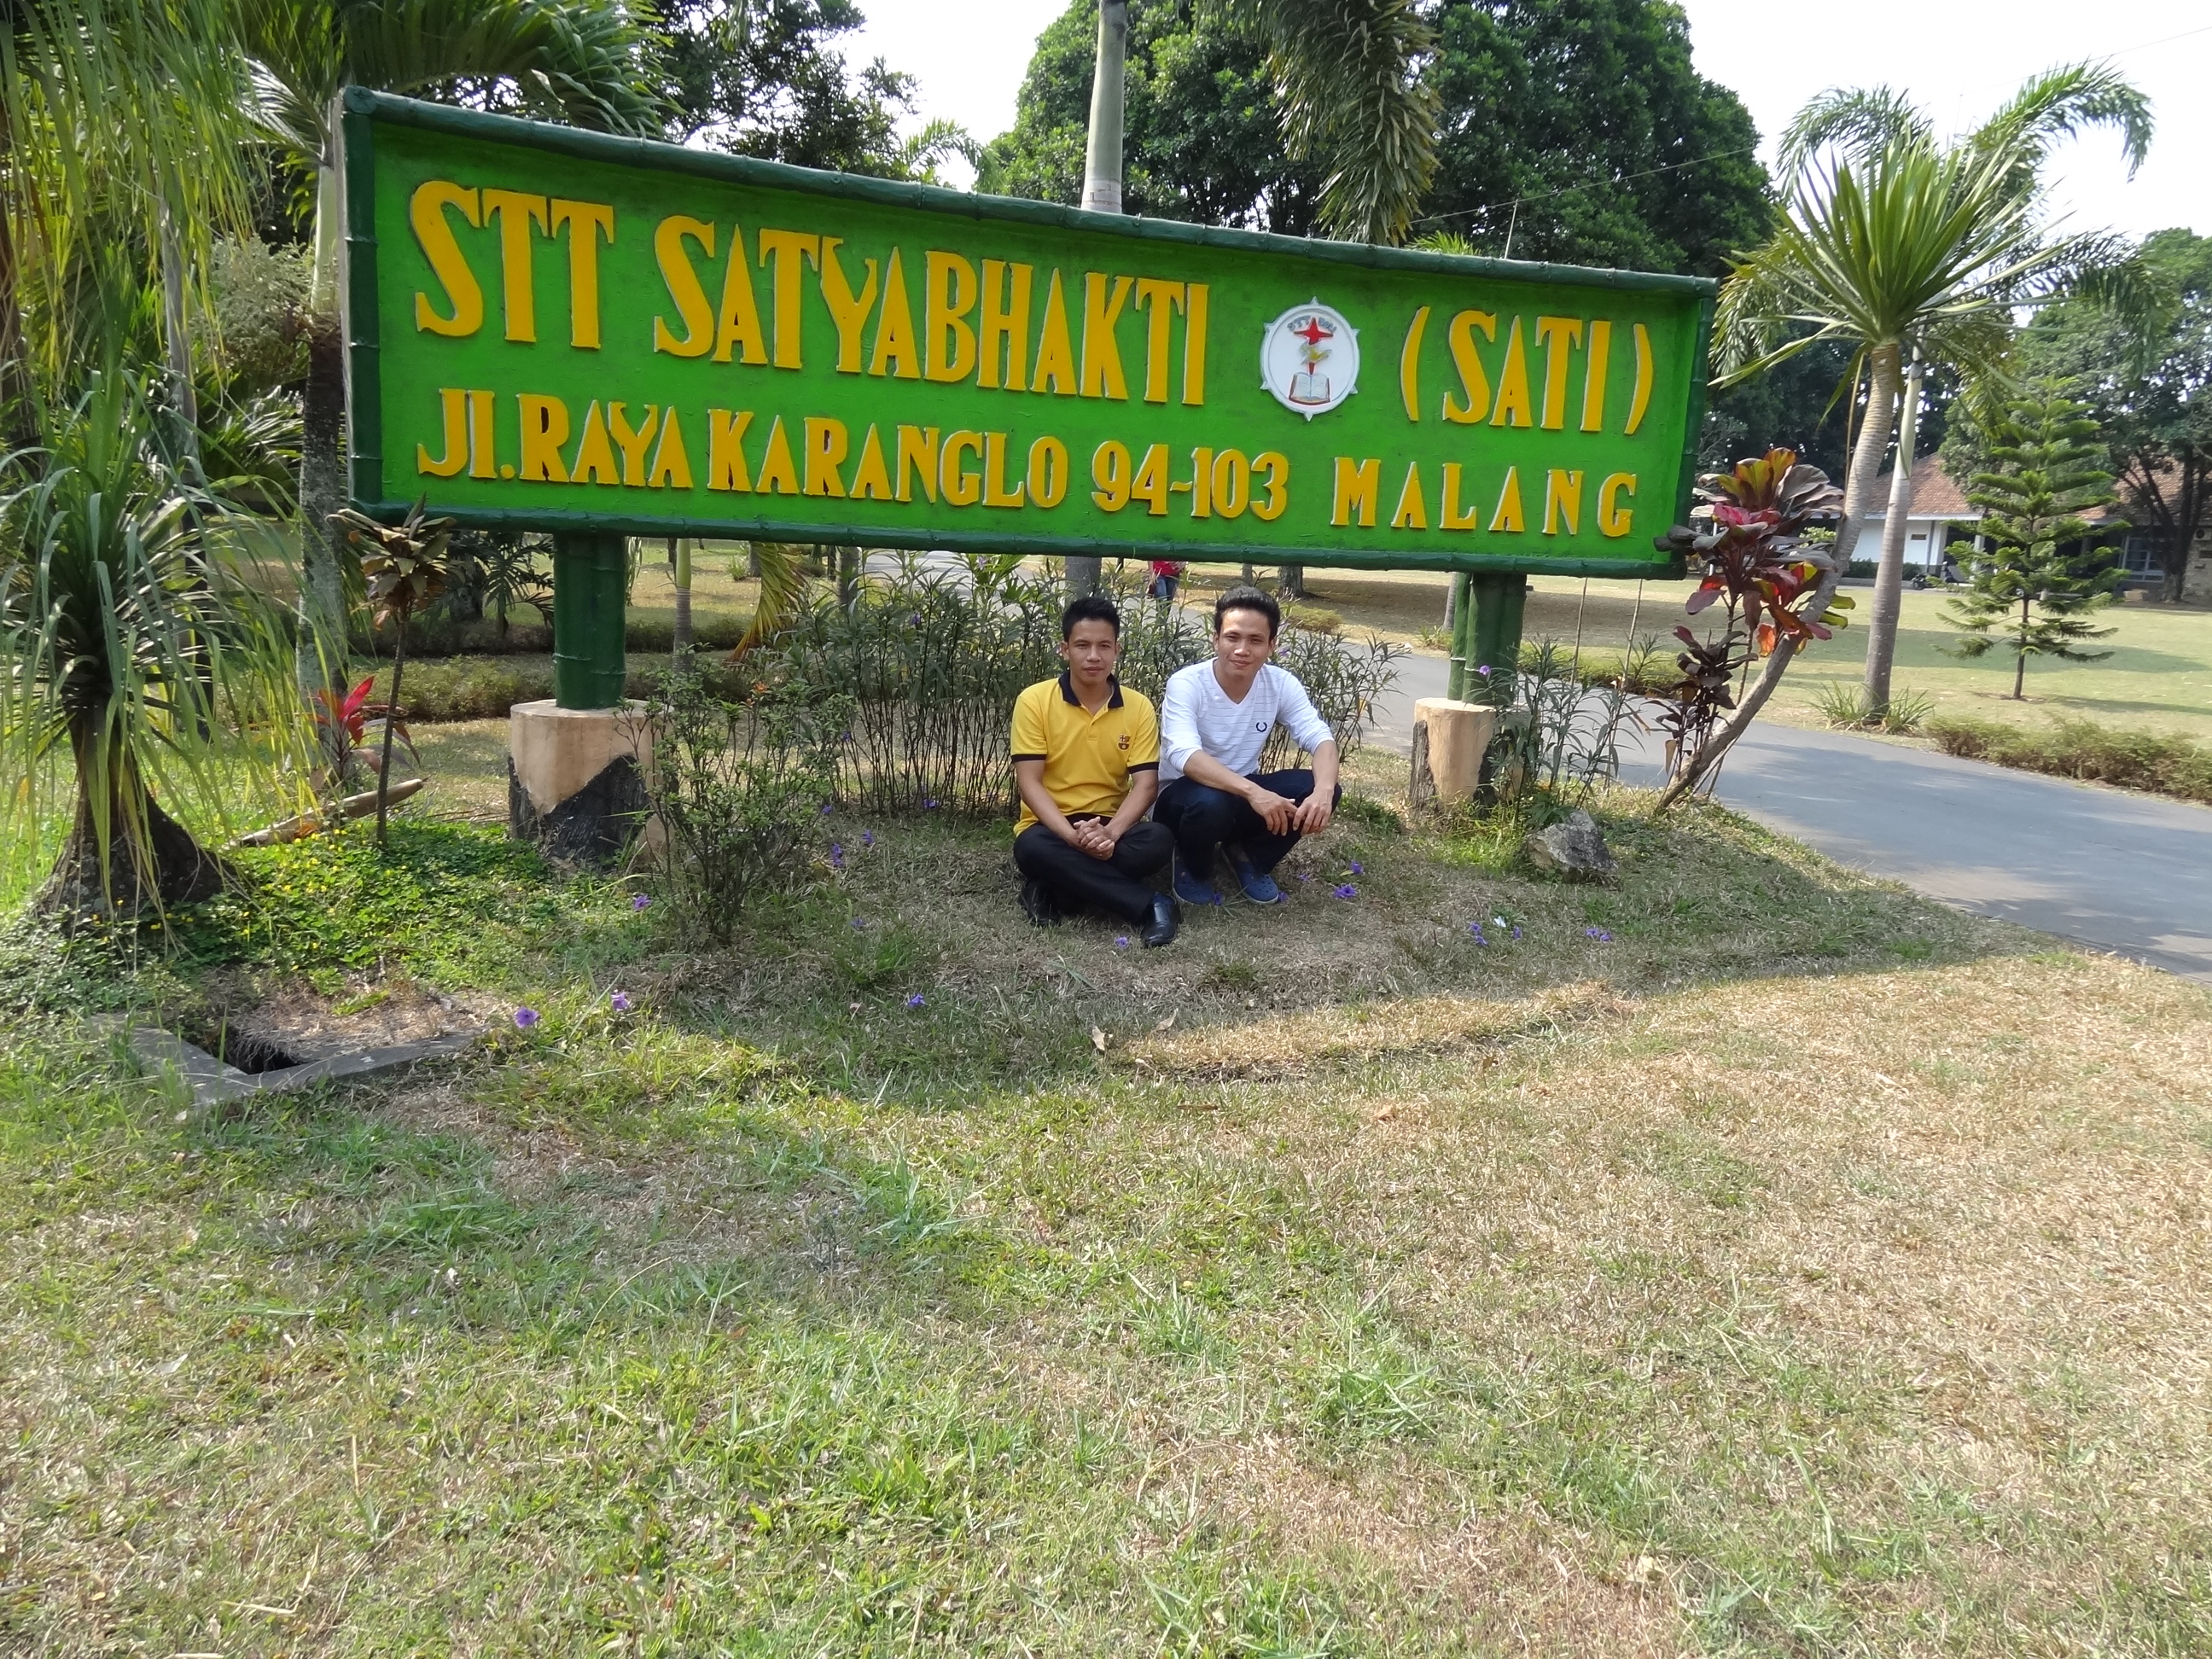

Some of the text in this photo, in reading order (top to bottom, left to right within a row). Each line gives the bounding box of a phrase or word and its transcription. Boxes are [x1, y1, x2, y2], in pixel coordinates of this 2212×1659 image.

[410, 179, 614, 350] STT
[654, 215, 1209, 406] SATYABHAKTI
[707, 409, 1069, 509] KARANGLO
[1091, 440, 1289, 521] 94-103
[1331, 457, 1637, 538] MALANG
